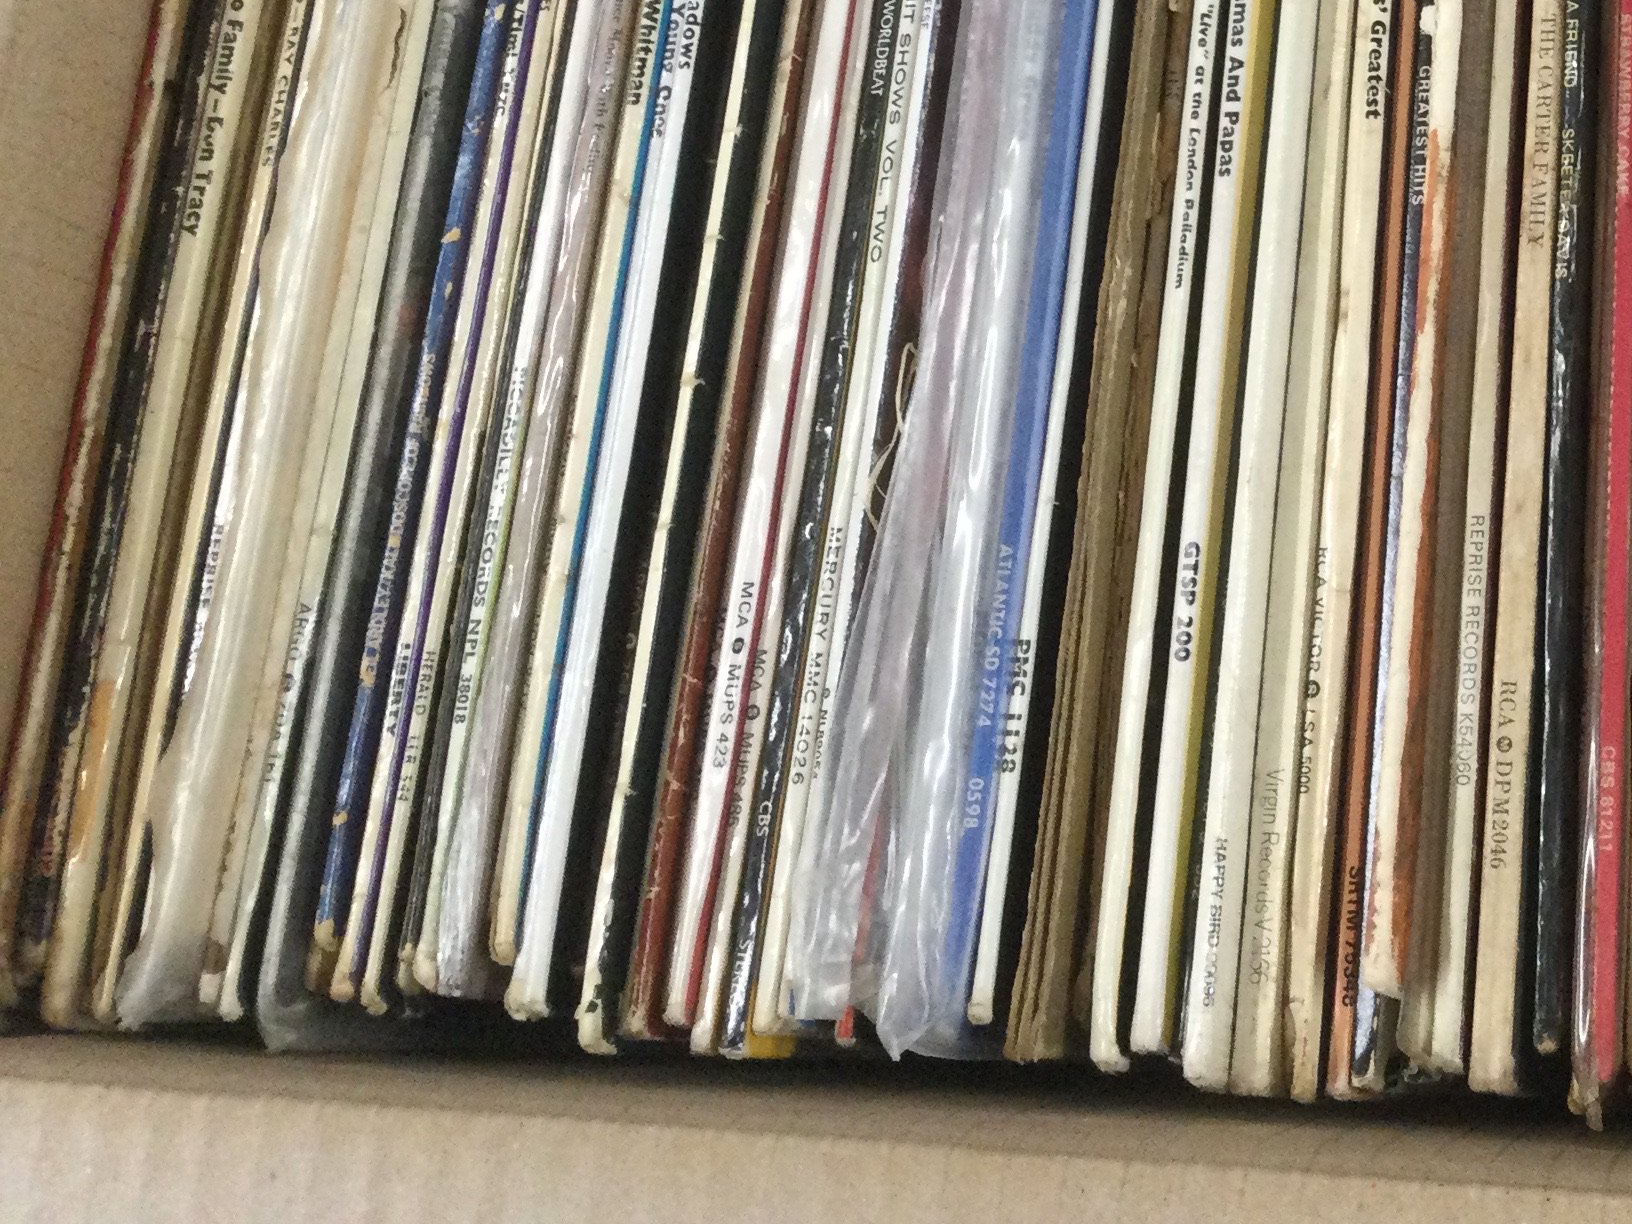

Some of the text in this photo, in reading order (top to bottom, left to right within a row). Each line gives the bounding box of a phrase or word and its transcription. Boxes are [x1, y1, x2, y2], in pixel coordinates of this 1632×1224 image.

[1565, 0, 1578, 14] A
[206, 20, 244, 94] Family
[887, 32, 912, 126] SHOWS
[1193, 64, 1206, 86] at
[1225, 56, 1245, 102] And
[1364, 20, 1387, 120] Greatest
[1189, 92, 1204, 120] the
[1410, 64, 1432, 206] GREATEST HITS
[1526, 12, 1557, 248] THE CARTER FAMILY
[878, 138, 896, 196] VOL.
[1216, 110, 1240, 178] Papas
[179, 170, 213, 236] Tracy
[868, 206, 888, 264] TWO
[735, 580, 755, 628] MCA
[1173, 540, 1202, 662] GTSP 200
[789, 528, 843, 784] MERCURY MMC 14026
[975, 542, 1013, 728] ATLANTIC SD 7274
[719, 664, 742, 724] MUPS
[997, 638, 1031, 774] PMC 1128
[711, 732, 731, 768] 423
[755, 800, 770, 836] CBS
[962, 776, 985, 828] 0598
